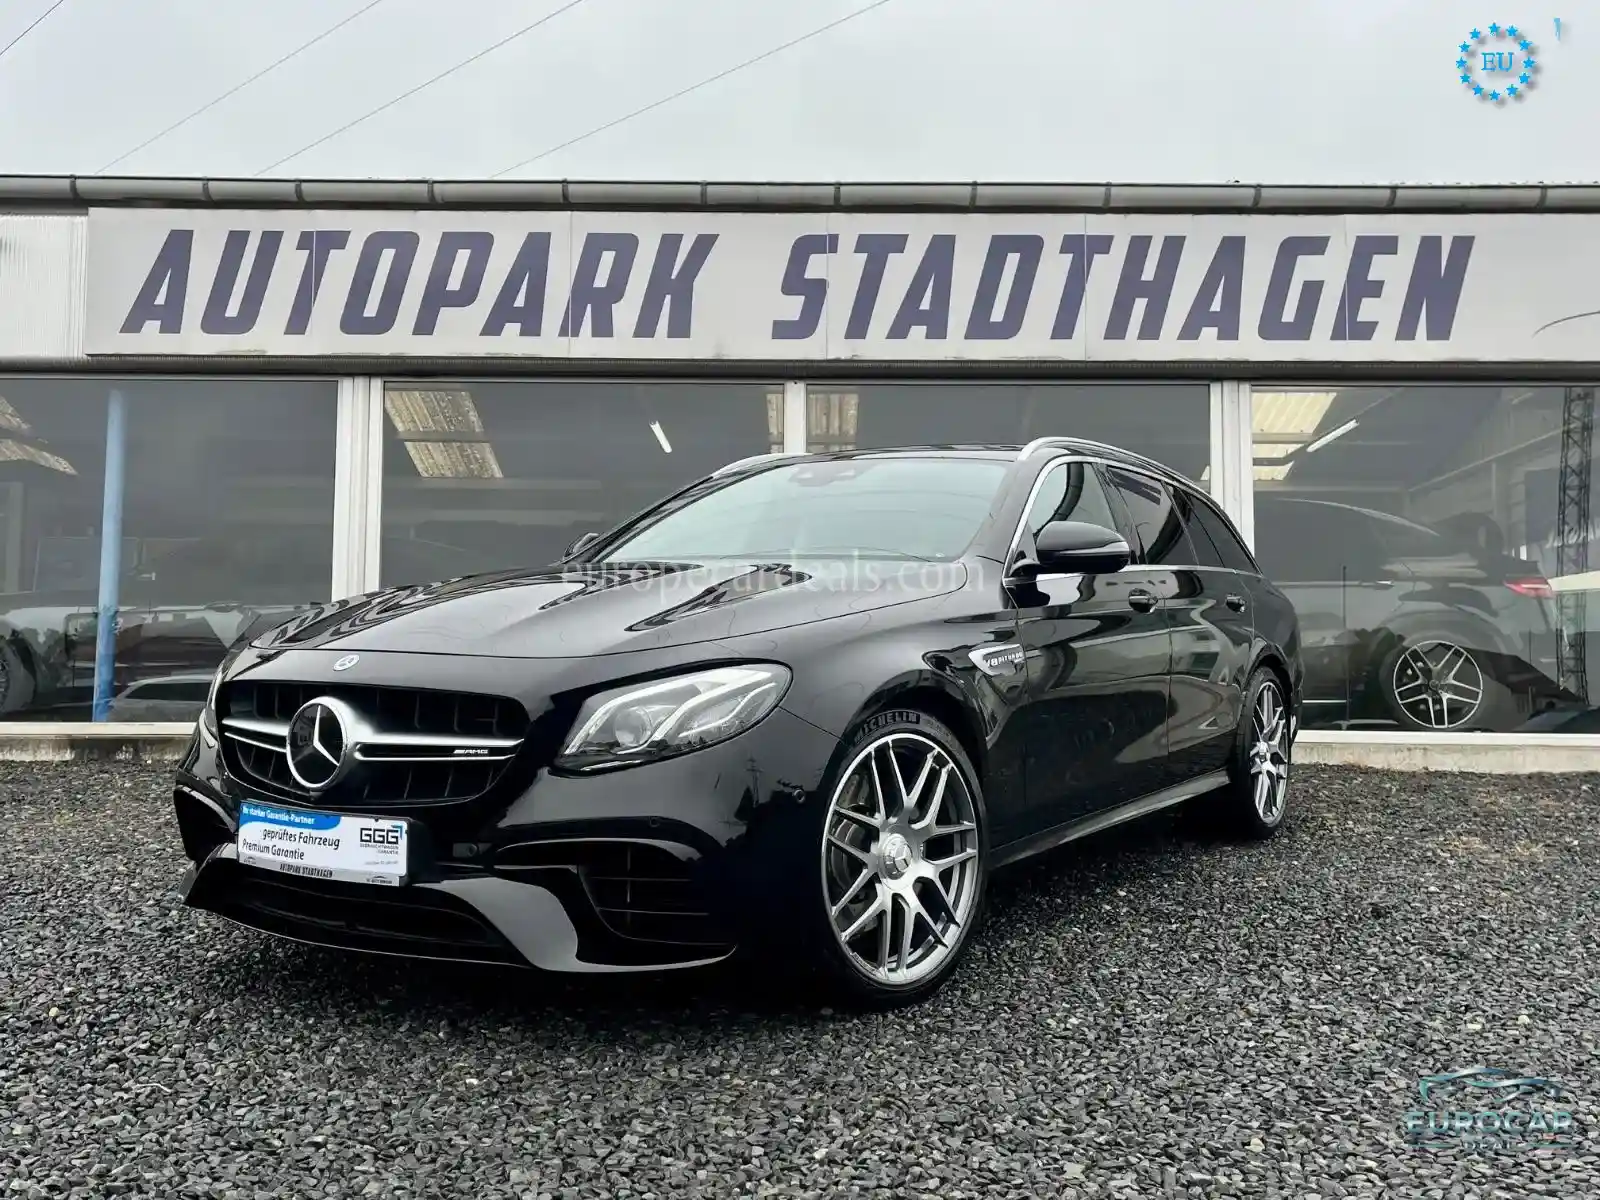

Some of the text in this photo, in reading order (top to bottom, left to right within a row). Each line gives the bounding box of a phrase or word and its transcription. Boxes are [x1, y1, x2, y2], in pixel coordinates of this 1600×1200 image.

[119, 229, 1476, 341] AUTOPARK STADTHAGEN
[854, 711, 917, 744] MICHELIN
[266, 810, 315, 825] Garantie-Partner
[263, 829, 341, 850] geprüftes Fahrzeug
[360, 828, 399, 844] GGG
[242, 838, 305, 860] Premium Garantie
